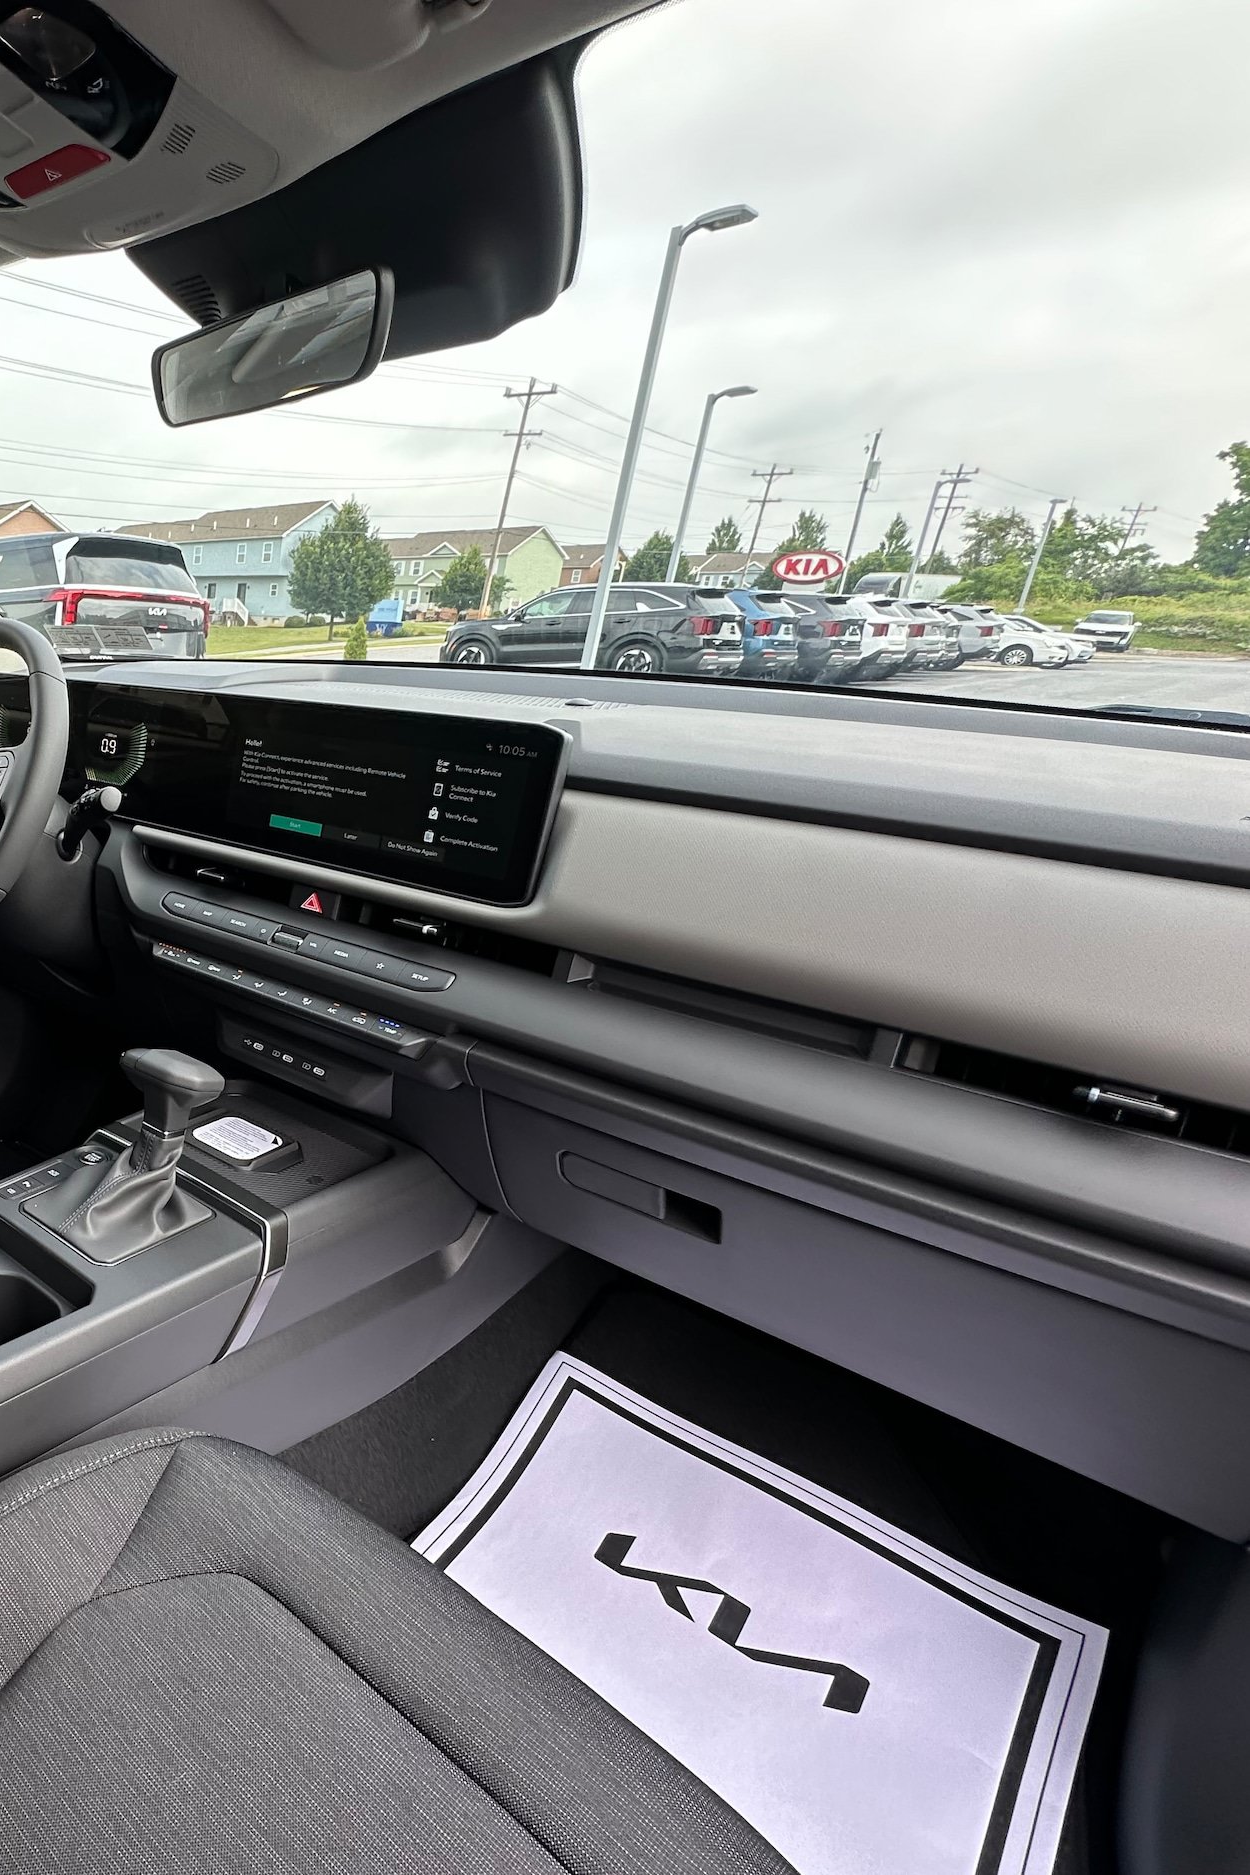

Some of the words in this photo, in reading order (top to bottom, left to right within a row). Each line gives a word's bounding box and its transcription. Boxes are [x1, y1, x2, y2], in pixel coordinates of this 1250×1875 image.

[783, 558, 829, 576] KIA
[148, 607, 168, 616] KIA
[245, 739, 262, 747] Hello!
[499, 745, 525, 756] 10:05
[388, 770, 406, 779] Vehicle
[455, 765, 472, 773] Terms
[480, 768, 502, 777] Service
[451, 785, 478, 795] Subscribe
[449, 793, 474, 803] Connect
[445, 812, 462, 821] Verify
[462, 815, 478, 823] Code
[344, 832, 358, 841] Later
[440, 835, 468, 847] Complete
[468, 841, 498, 852] Activation
[407, 845, 421, 854] Show
[421, 848, 438, 857] Again
[411, 972, 429, 981] SETUP
